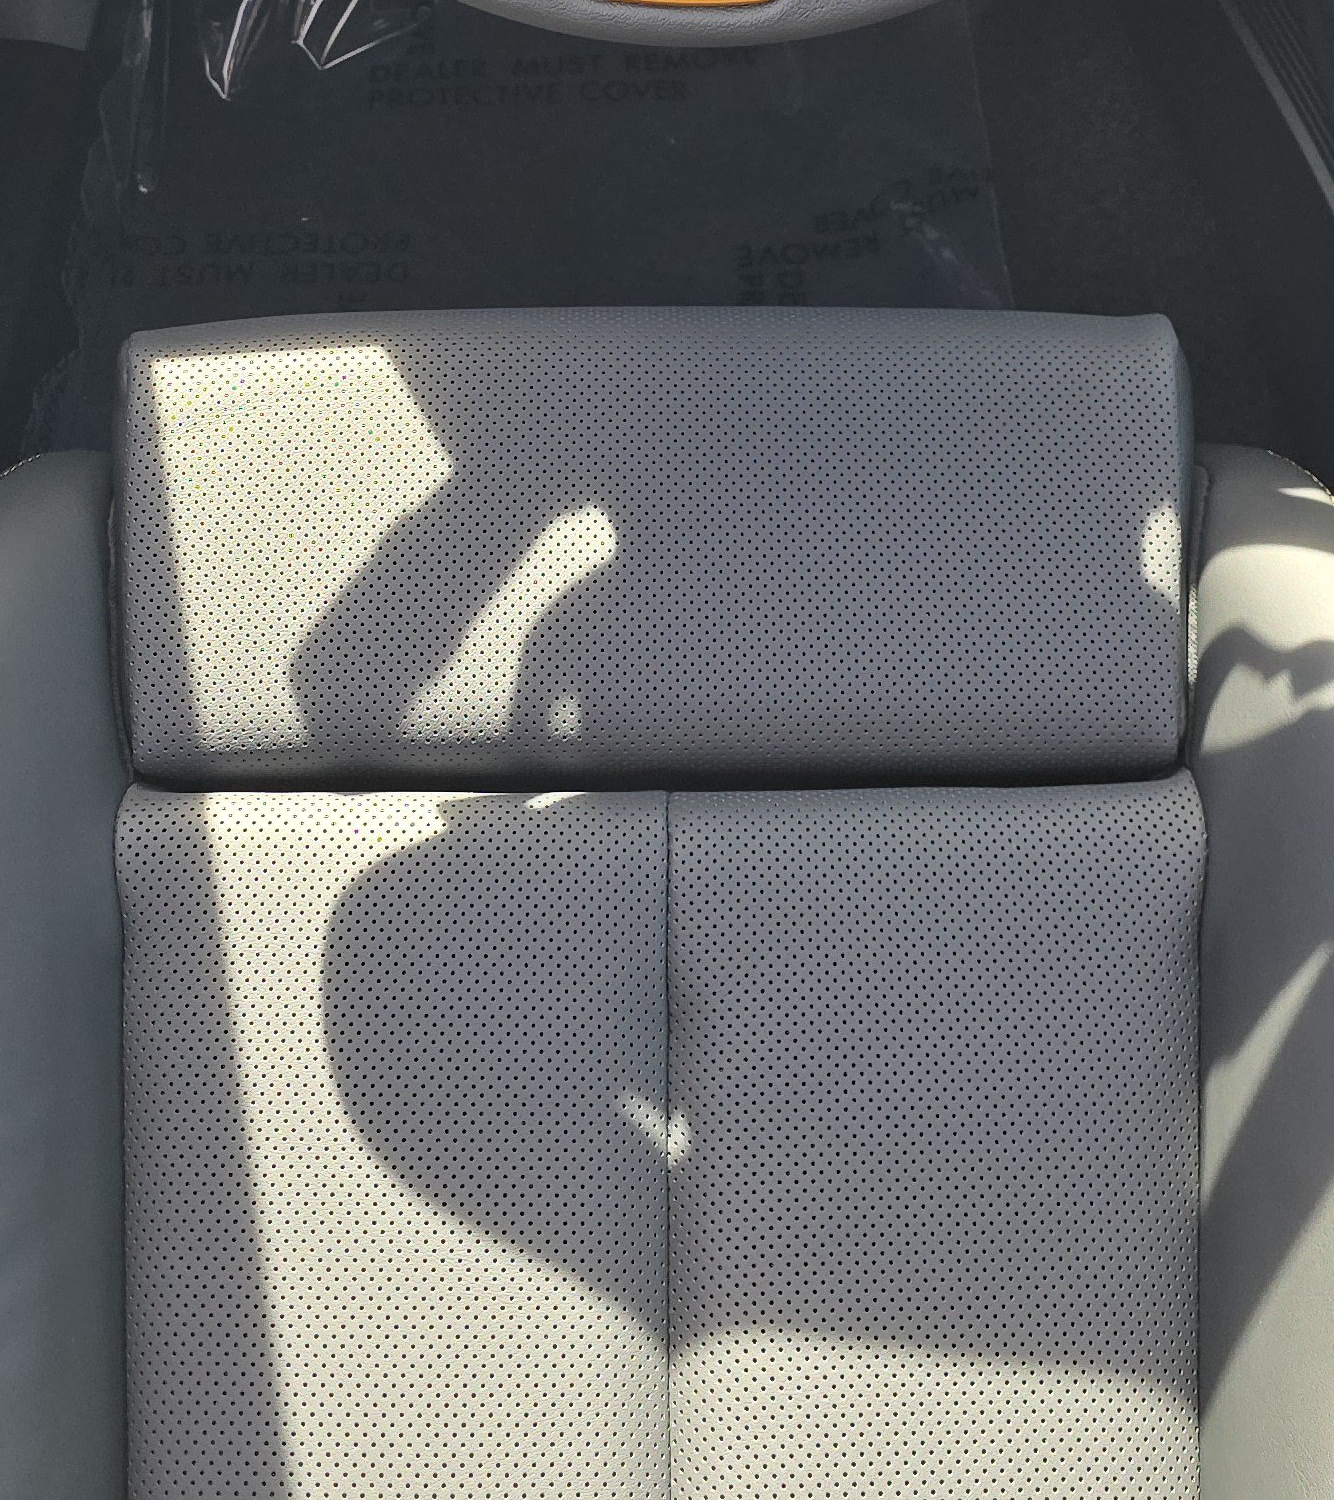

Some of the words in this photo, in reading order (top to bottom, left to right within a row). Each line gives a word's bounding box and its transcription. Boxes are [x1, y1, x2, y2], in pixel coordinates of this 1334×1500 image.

[369, 58, 486, 84] DEALER
[511, 52, 603, 77] MUST
[368, 82, 564, 110] PROTECTIVE
[578, 80, 688, 103] COVER
